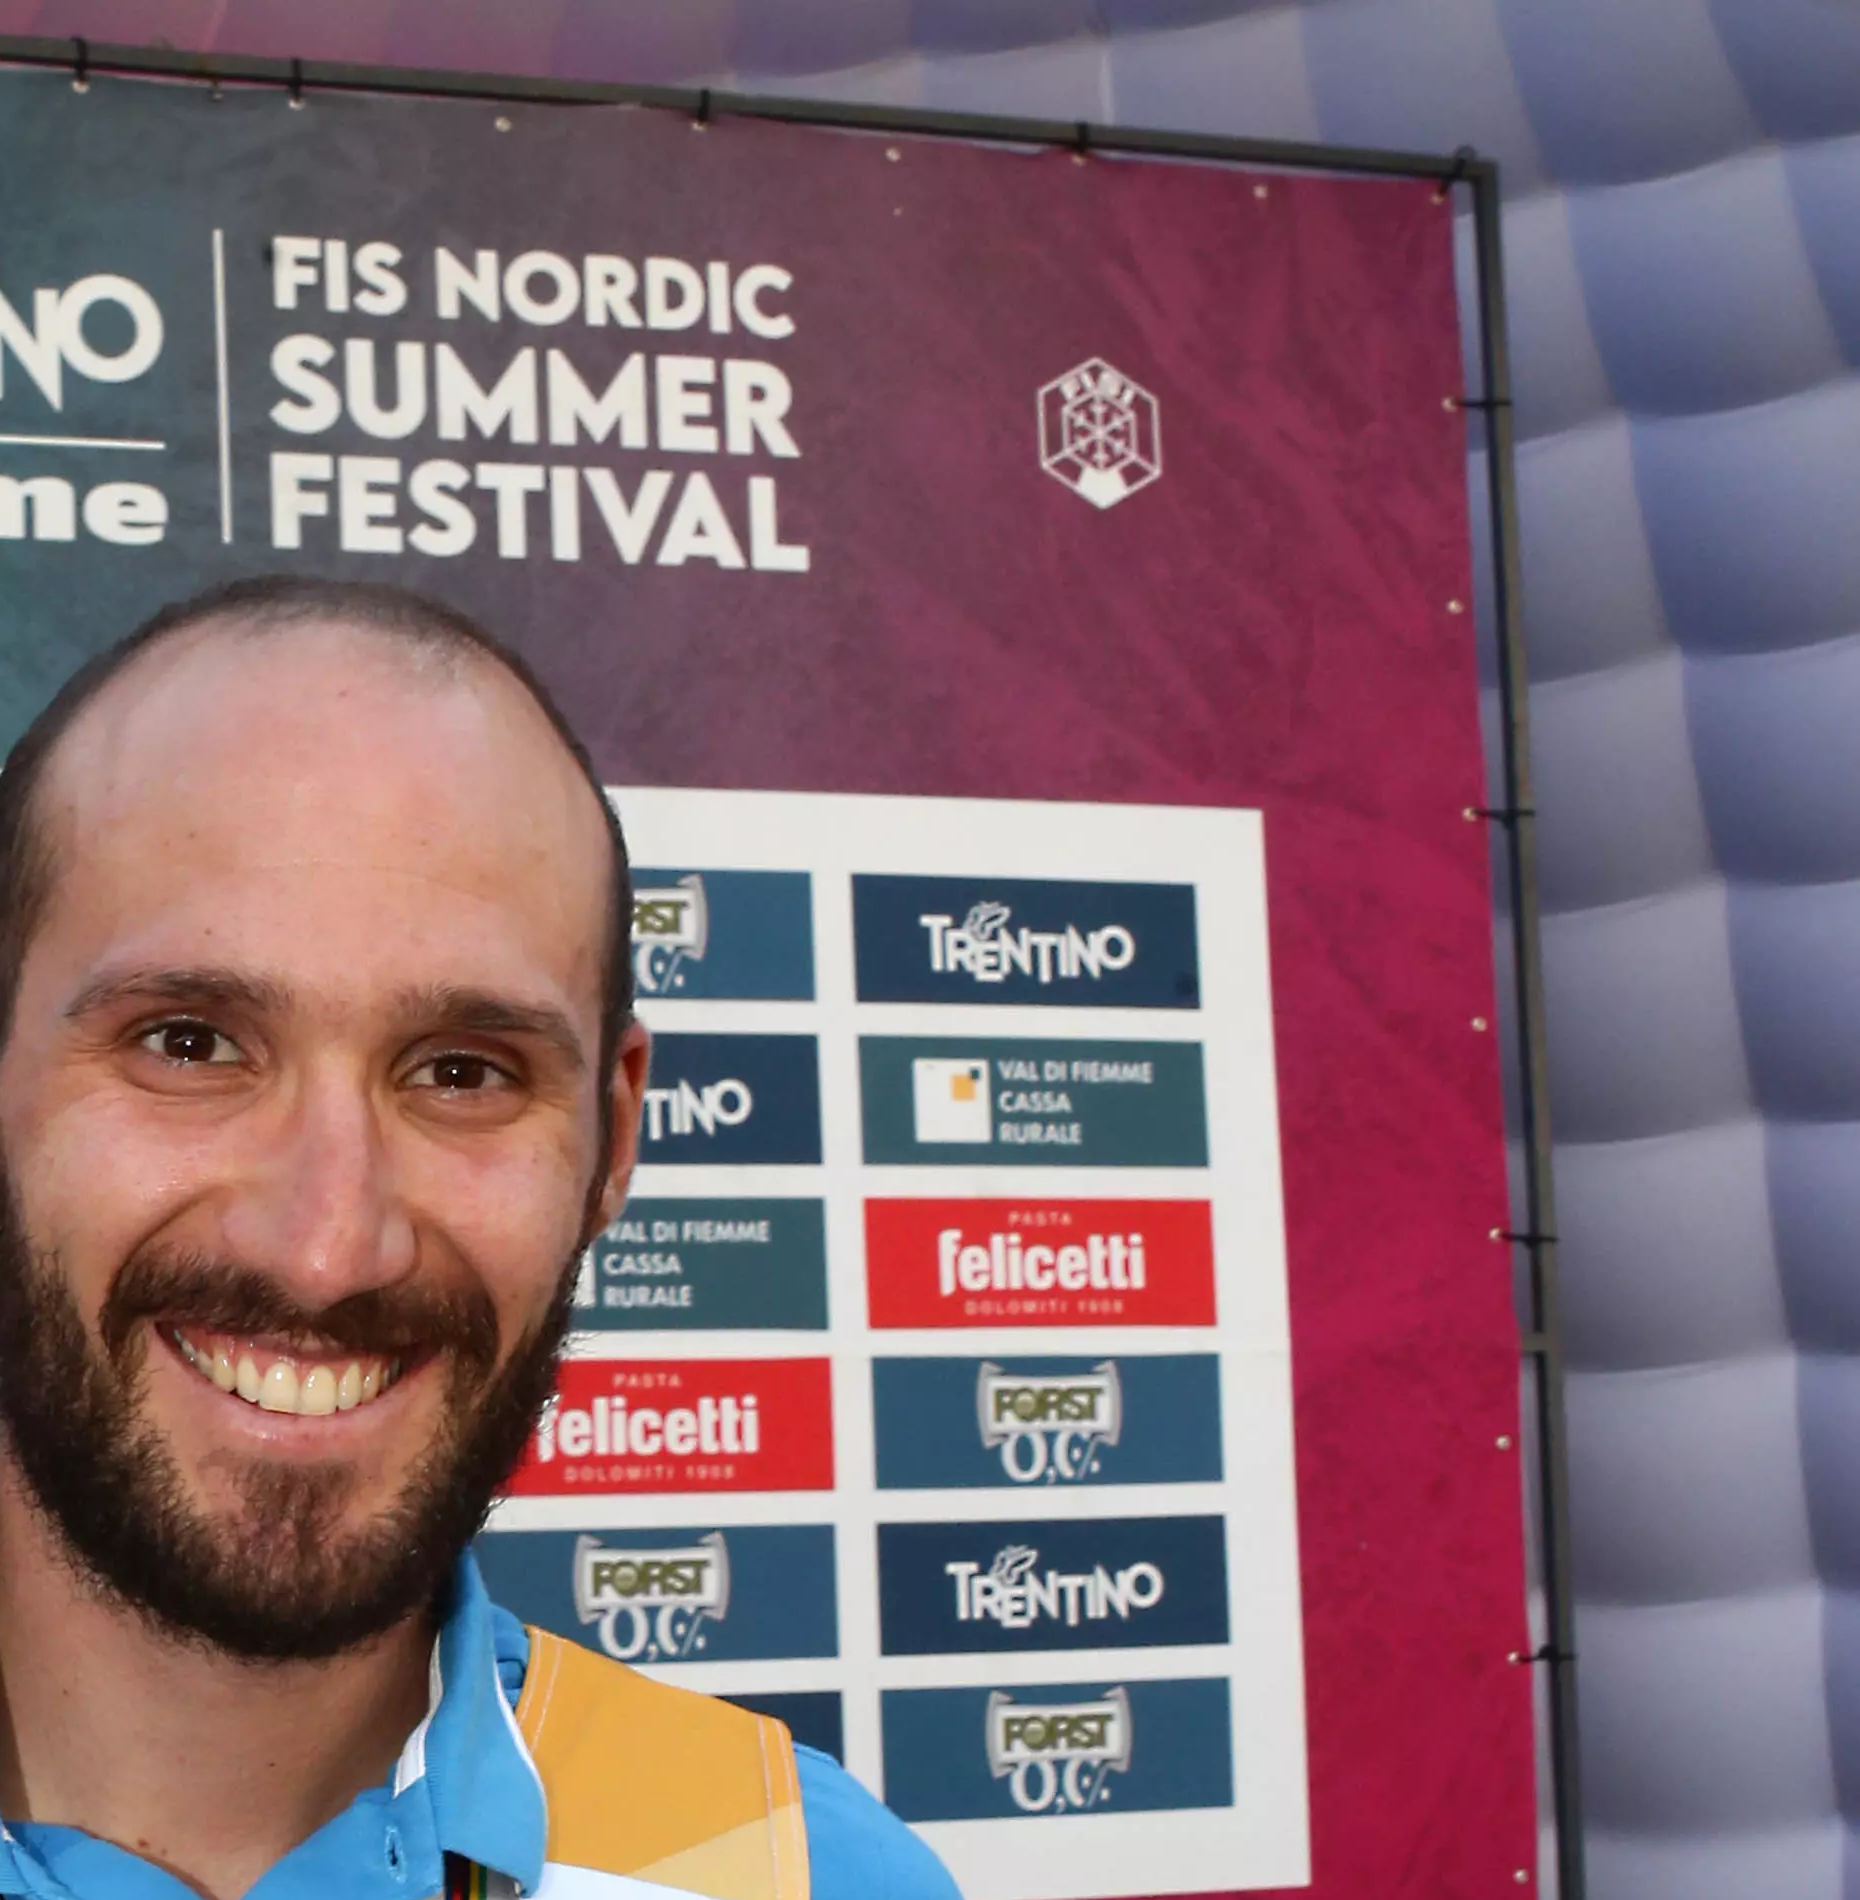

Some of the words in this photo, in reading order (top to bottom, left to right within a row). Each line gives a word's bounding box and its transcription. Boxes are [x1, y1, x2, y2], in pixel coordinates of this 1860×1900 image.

[270, 235, 407, 317] FIS
[435, 246, 796, 339] NORDIC
[268, 334, 801, 458] SUMMER
[269, 451, 811, 573] FESTIVAL
[919, 914, 1135, 984] TRENTINO
[998, 1060, 1040, 1081] VAL
[1045, 1061, 1068, 1082] DI
[1072, 1062, 1154, 1084] FIEMME
[643, 1078, 753, 1141] TINO
[998, 1091, 1072, 1113] CASSA
[998, 1122, 1082, 1145] RURALE
[605, 1221, 647, 1242] VAL
[652, 1221, 678, 1242] DI
[683, 1221, 772, 1243] FIEMME
[603, 1253, 682, 1276] CASSA
[938, 1229, 1146, 1297] felicetti
[603, 1284, 693, 1307] RURALE
[993, 1386, 1105, 1423] FORST
[537, 1394, 760, 1462] felicetti
[592, 1558, 712, 1597] FORST
[945, 1562, 1165, 1629] TRENTINO
[1003, 1712, 1116, 1753] FORST
